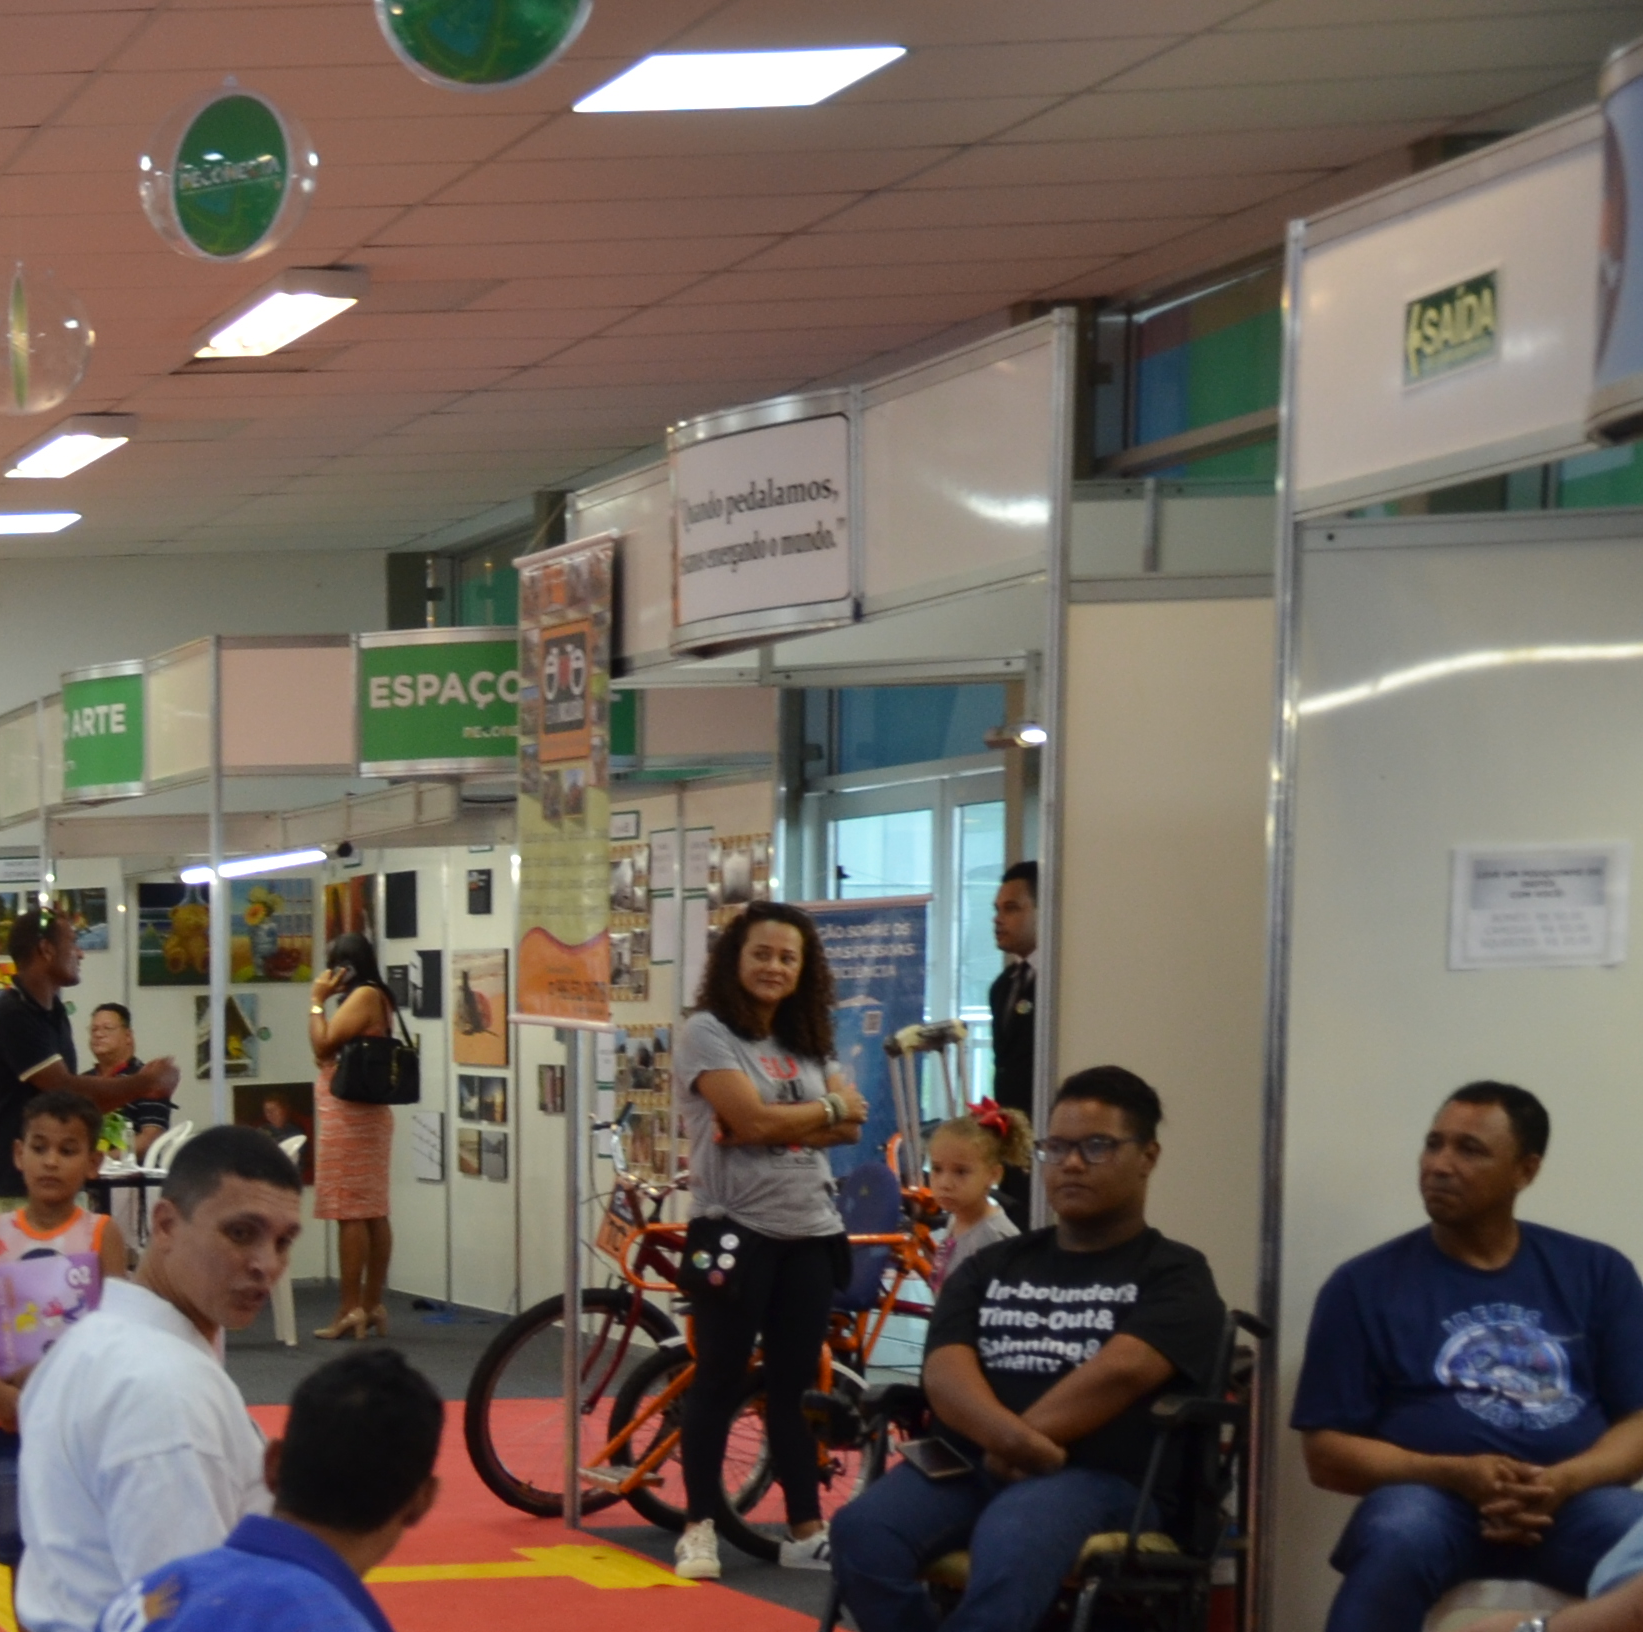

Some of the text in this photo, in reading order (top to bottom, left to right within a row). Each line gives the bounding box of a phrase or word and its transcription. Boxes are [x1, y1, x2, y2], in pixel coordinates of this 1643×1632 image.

[1422, 285, 1494, 355] SAÍDA
[725, 478, 840, 525] pedalamos,
[369, 669, 520, 710] ESPAÇO
[71, 703, 127, 738] ARTE
[978, 1306, 1114, 1331] Time-Out&
